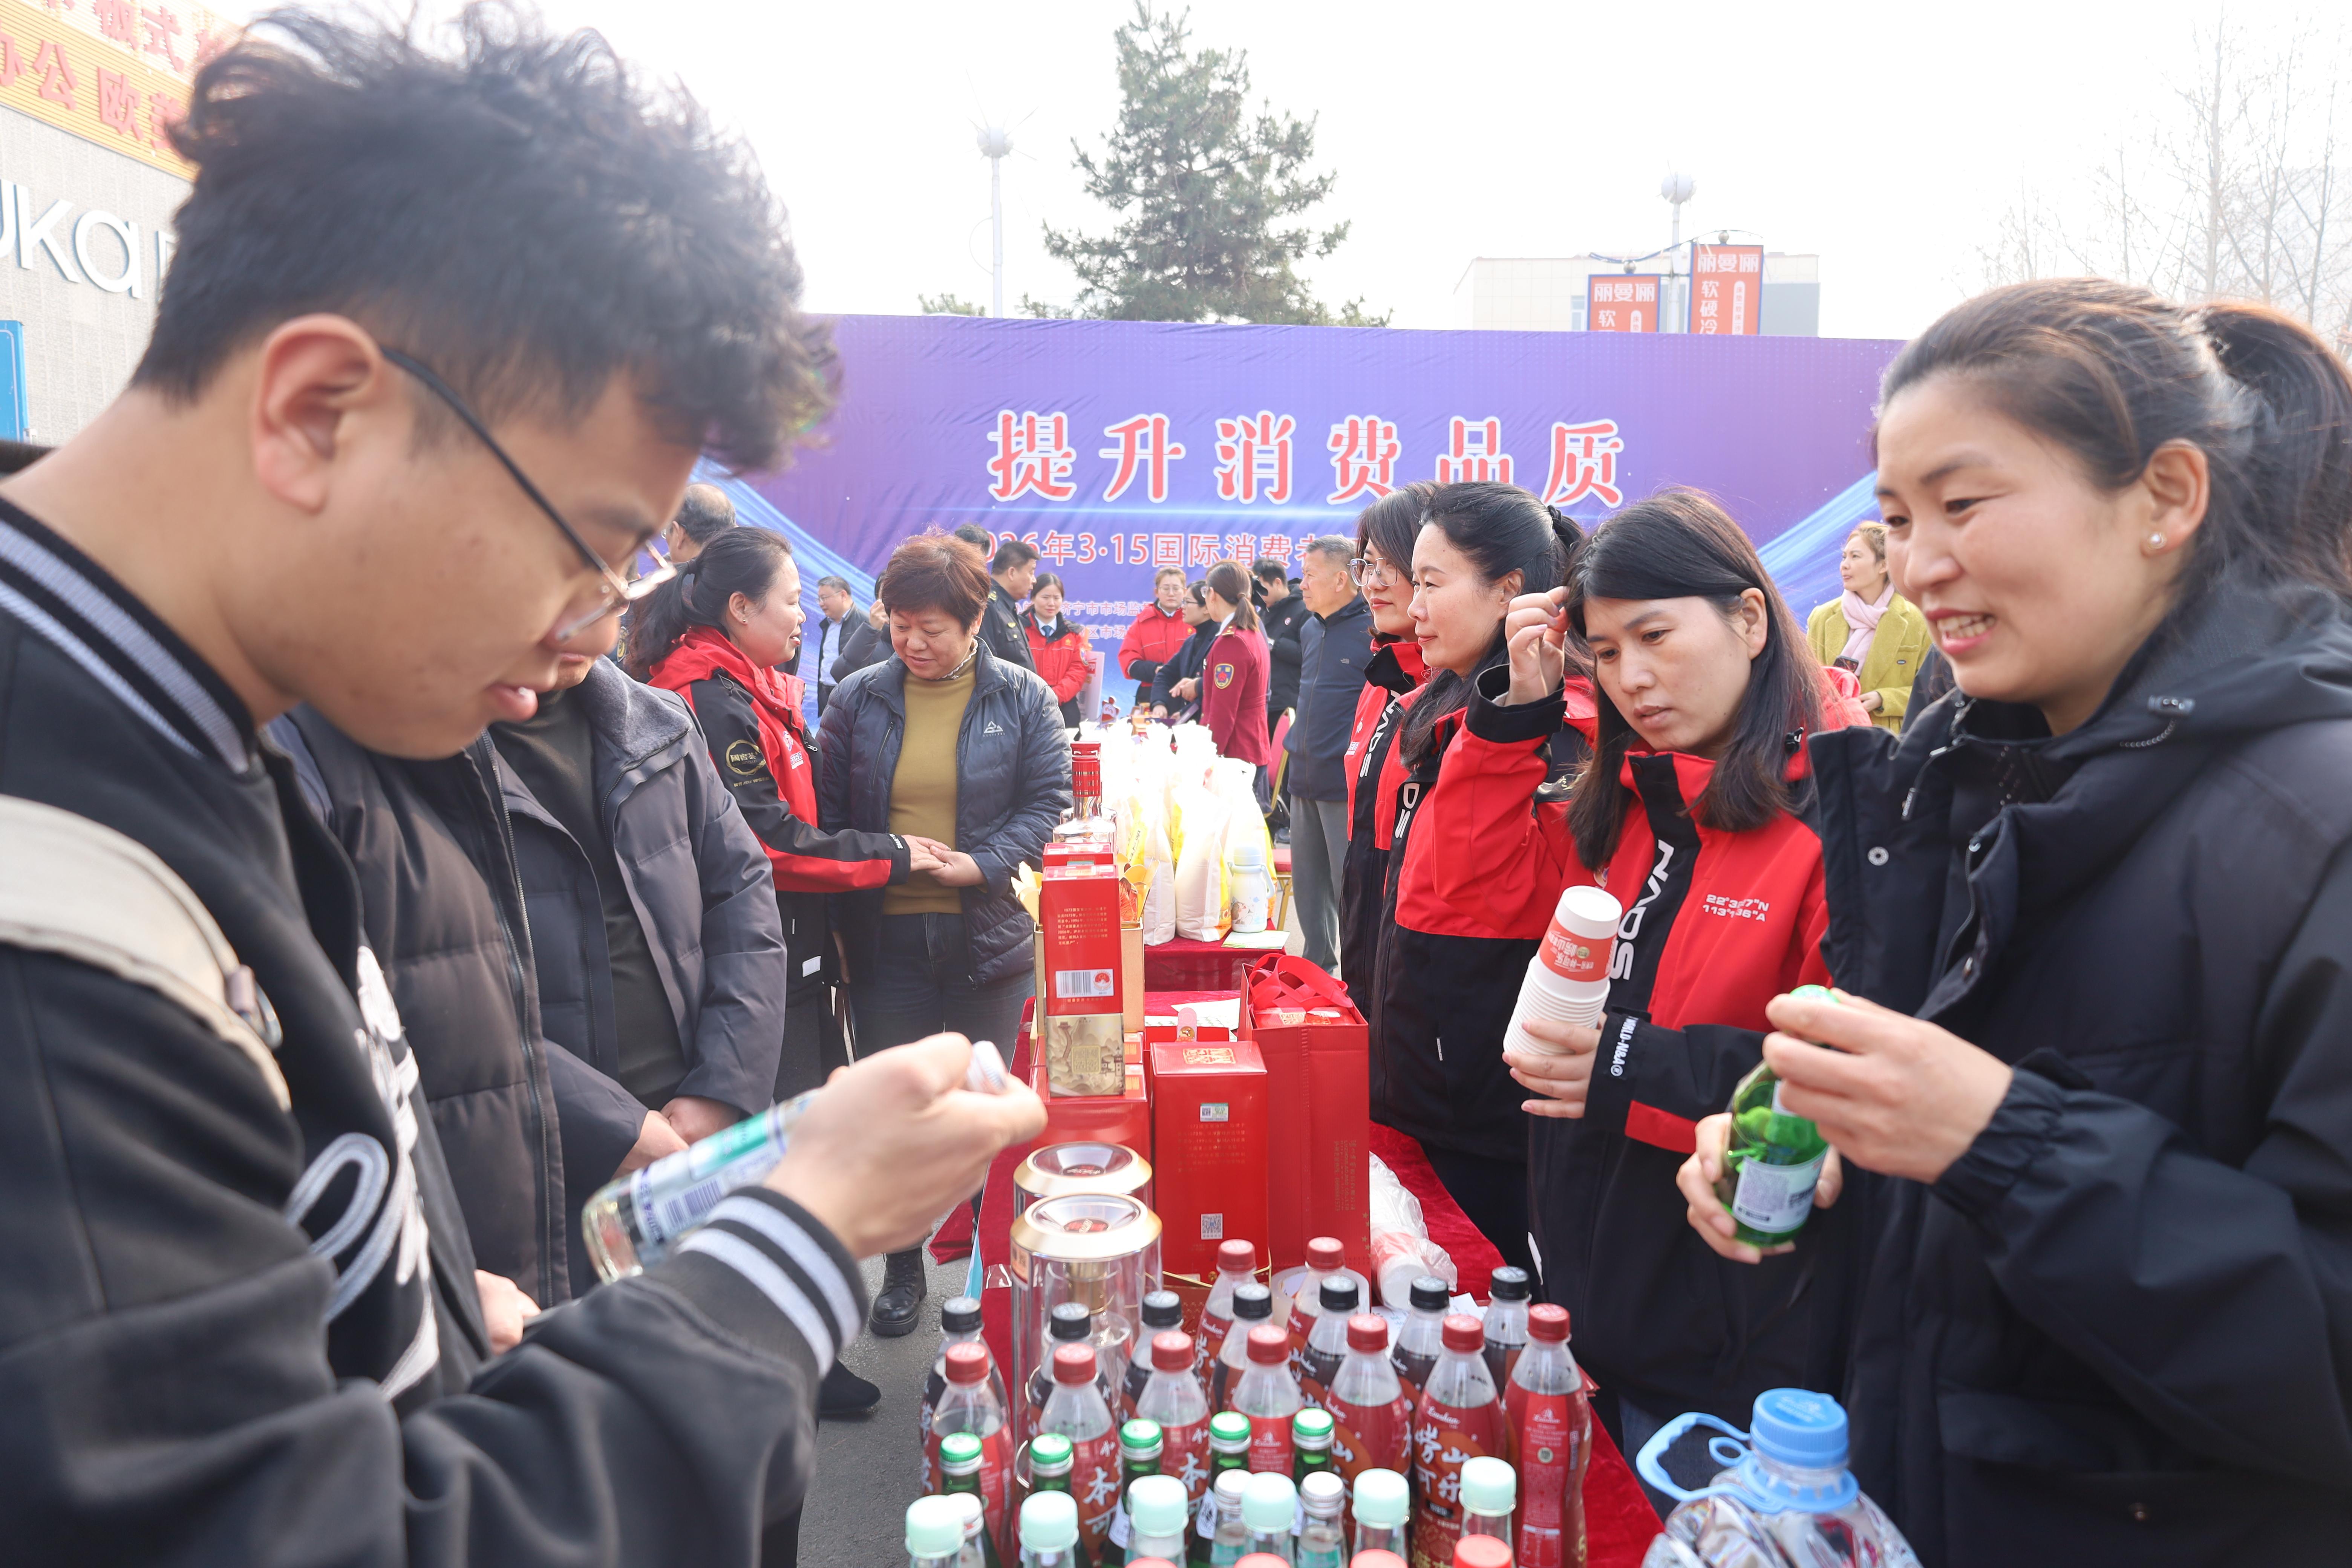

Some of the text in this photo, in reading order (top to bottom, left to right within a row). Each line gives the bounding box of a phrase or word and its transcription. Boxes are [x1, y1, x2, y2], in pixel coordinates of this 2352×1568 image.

[1698, 254, 1759, 273] 丽曼俪
[1594, 283, 1655, 302] 丽曼俪
[1598, 310, 1616, 331] 软
[987, 409, 1624, 508] 提升消费品质
